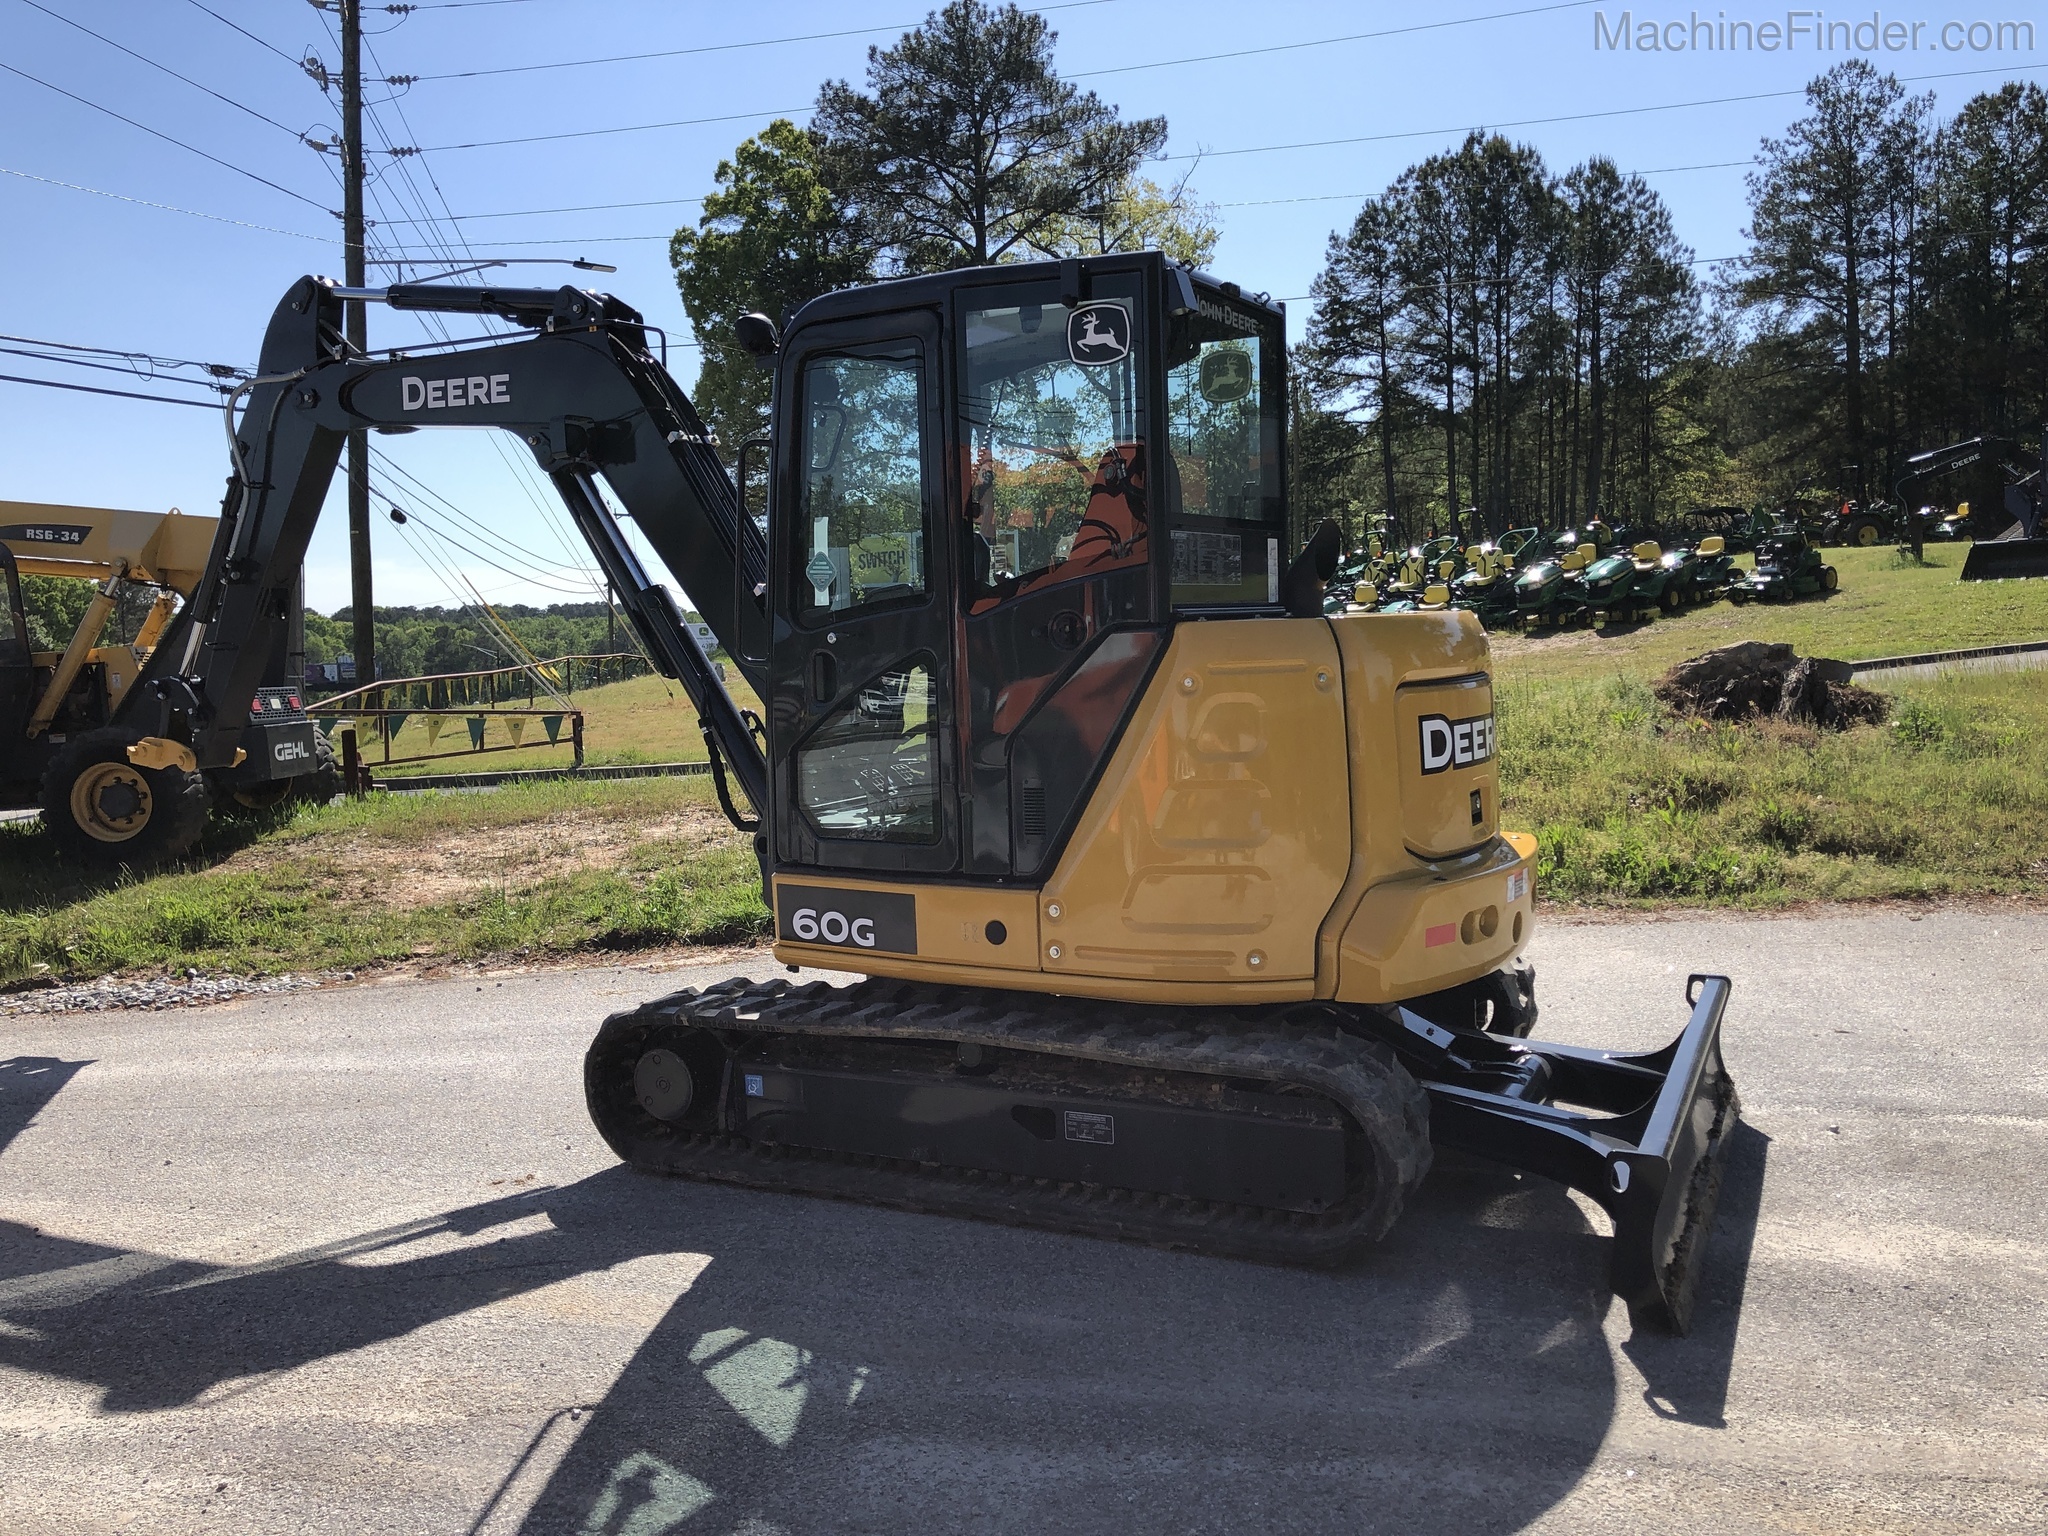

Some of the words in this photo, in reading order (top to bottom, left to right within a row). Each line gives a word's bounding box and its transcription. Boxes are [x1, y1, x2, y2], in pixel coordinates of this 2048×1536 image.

[1224, 305, 1259, 334] DEERE
[401, 373, 511, 411] DEERE
[1951, 452, 1981, 469] DEERE
[26, 528, 80, 542] RS6-34
[858, 550, 906, 570] SWITCH
[274, 741, 310, 761] GEHL
[792, 908, 876, 948] 60G
